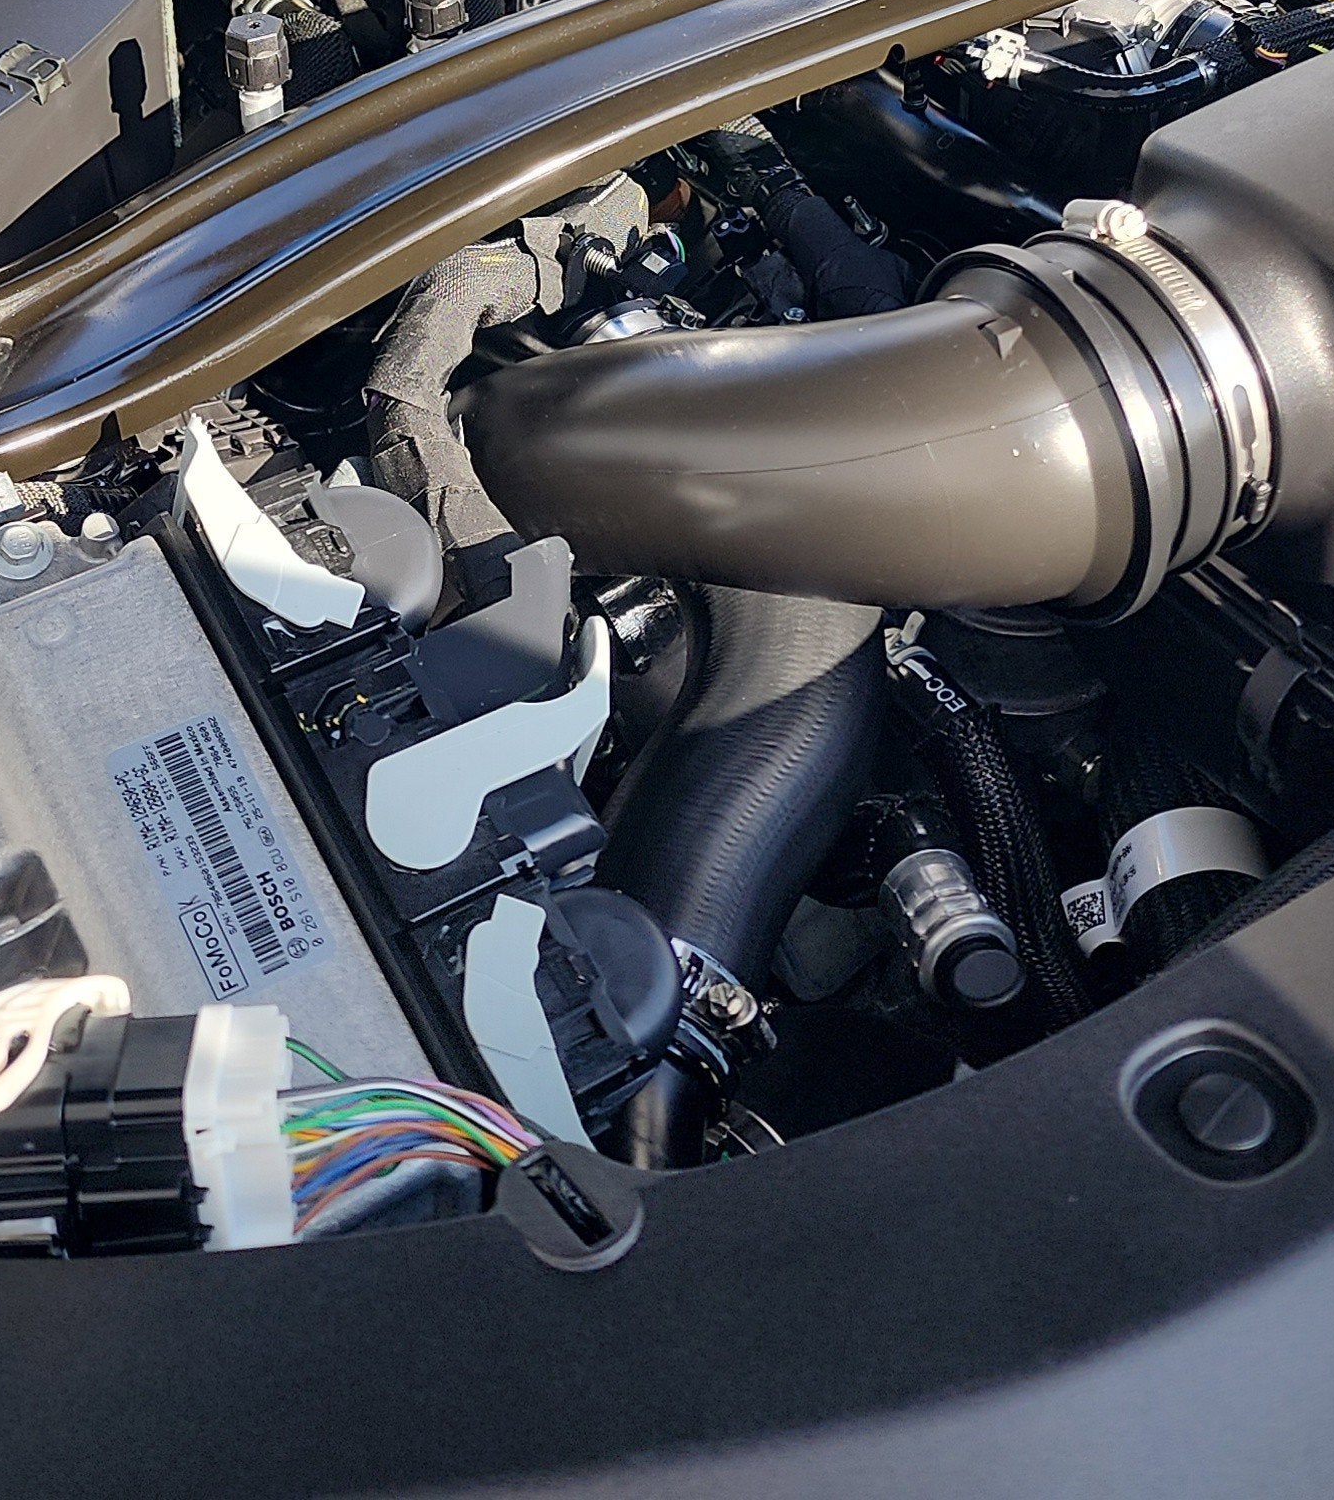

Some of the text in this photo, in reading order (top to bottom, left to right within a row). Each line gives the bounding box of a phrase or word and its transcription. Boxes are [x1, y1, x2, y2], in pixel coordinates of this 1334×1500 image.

[926, 677, 967, 713] EOC
[184, 724, 203, 755] Mexico
[156, 772, 174, 800] SITE:
[203, 765, 232, 813] Assembled
[154, 852, 172, 877] P/N:
[172, 844, 189, 869] H/W:
[256, 870, 295, 931] BOSCH
[220, 910, 237, 934] S/N:
[297, 908, 317, 932] 261
[189, 909, 238, 991] FoMoCo
